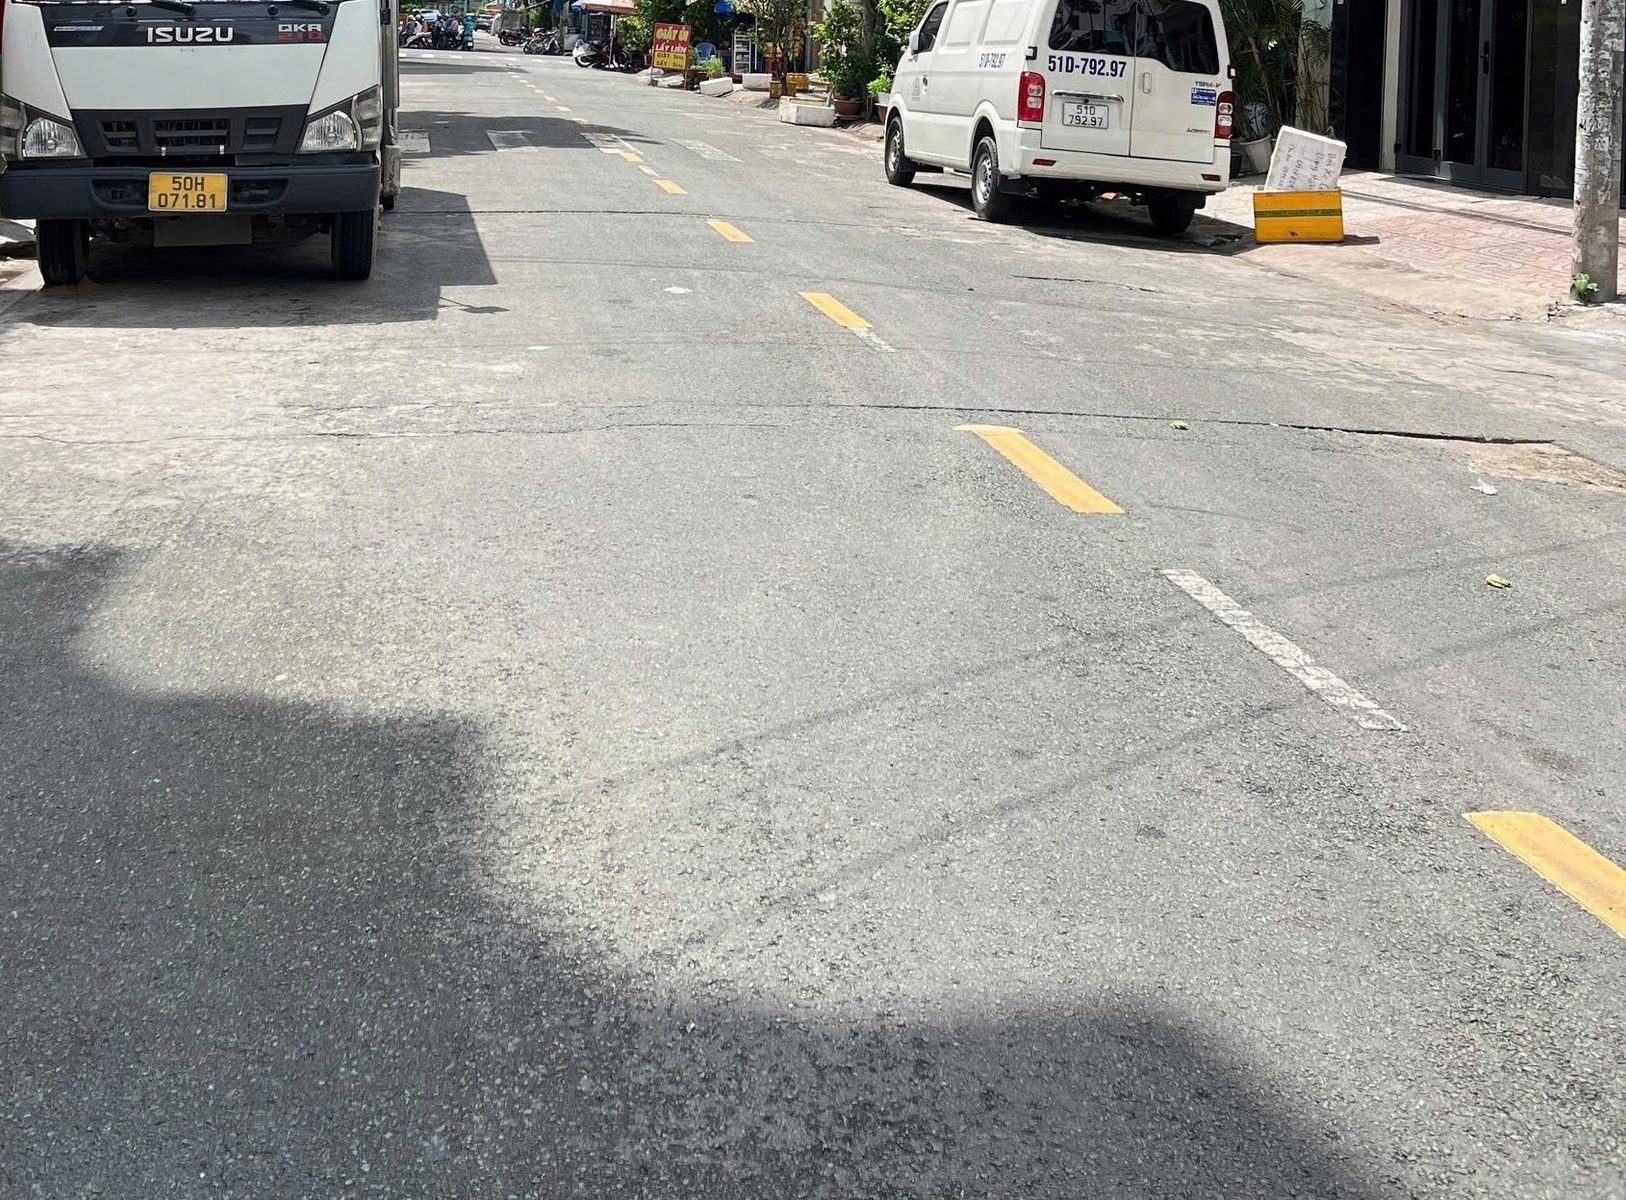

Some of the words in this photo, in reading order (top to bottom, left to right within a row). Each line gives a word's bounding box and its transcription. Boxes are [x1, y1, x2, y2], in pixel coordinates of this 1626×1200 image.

[147, 26, 234, 43] ISUZU
[278, 23, 322, 32] QKR
[1048, 54, 1127, 78] 51D-792.97
[1076, 105, 1096, 116] 51D
[1068, 114, 1104, 127] 792.97
[172, 176, 205, 192] 50H
[158, 192, 216, 209] 071.81
